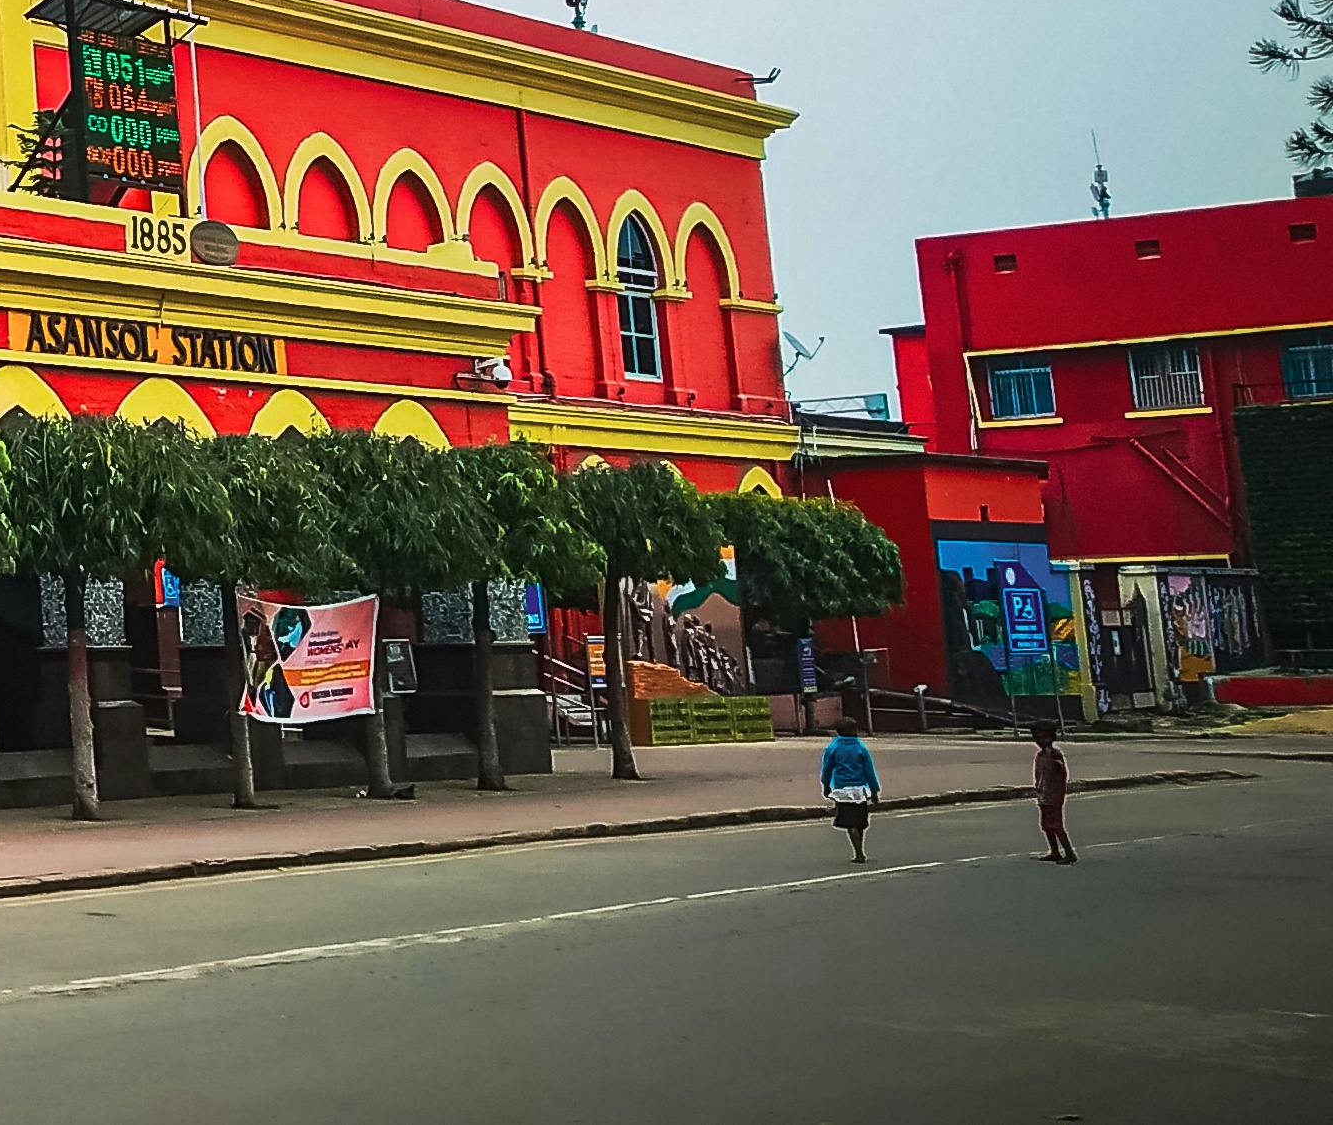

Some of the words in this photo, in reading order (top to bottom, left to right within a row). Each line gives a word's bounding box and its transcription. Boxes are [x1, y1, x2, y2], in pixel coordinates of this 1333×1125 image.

[106, 52, 145, 86] 051
[111, 115, 152, 148] 000
[113, 146, 154, 178] 000
[131, 216, 186, 255] 1885
[26, 314, 159, 362] ASANSOL
[171, 328, 278, 374] STATION
